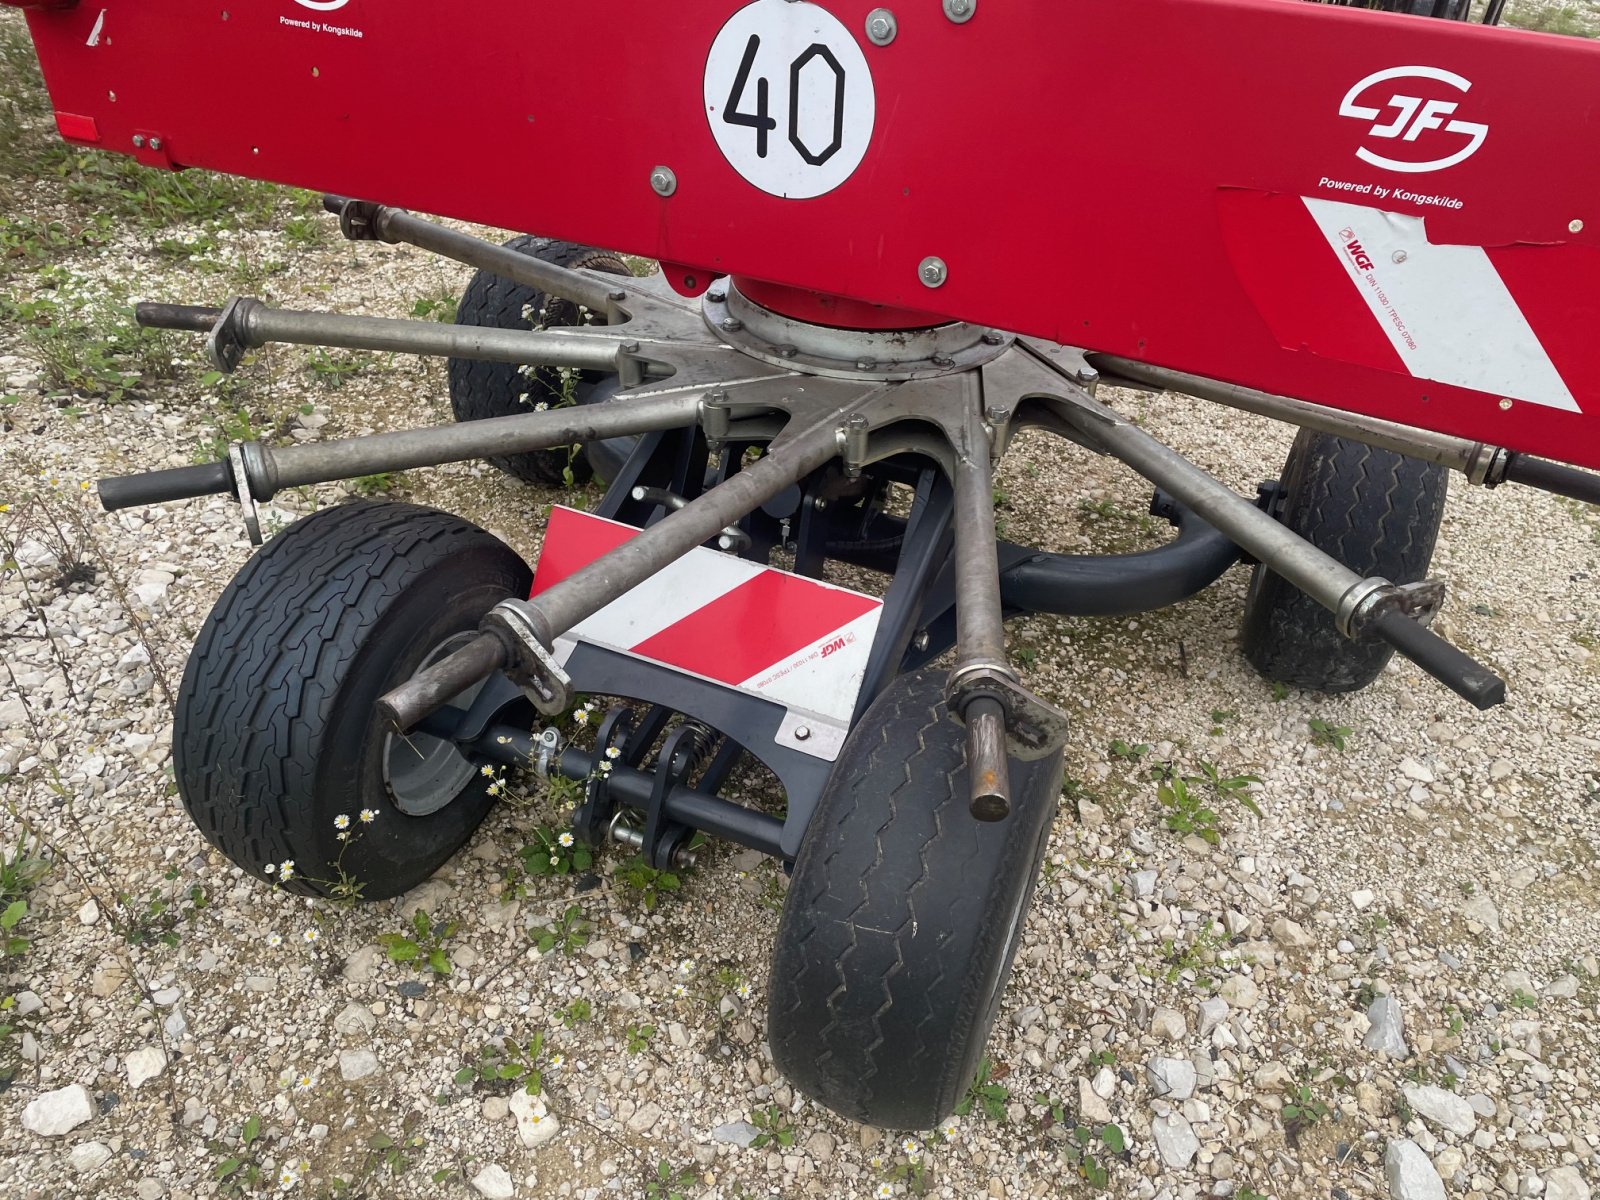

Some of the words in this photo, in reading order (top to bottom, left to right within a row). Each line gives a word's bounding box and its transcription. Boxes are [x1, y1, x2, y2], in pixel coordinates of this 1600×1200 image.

[280, 16, 310, 29] Powered
[312, 22, 320, 32] by
[322, 23, 363, 38] Kongskilde
[723, 34, 845, 166] 40
[1368, 94, 1459, 141] JF
[1318, 177, 1372, 194] Powered
[1373, 185, 1390, 199] by
[1392, 188, 1464, 210] Kongskilde
[1347, 240, 1374, 271] WGF
[1366, 274, 1376, 287] DIN
[1374, 286, 1389, 306] 11030
[1388, 308, 1405, 332] TPESC
[820, 638, 846, 658] WGF
